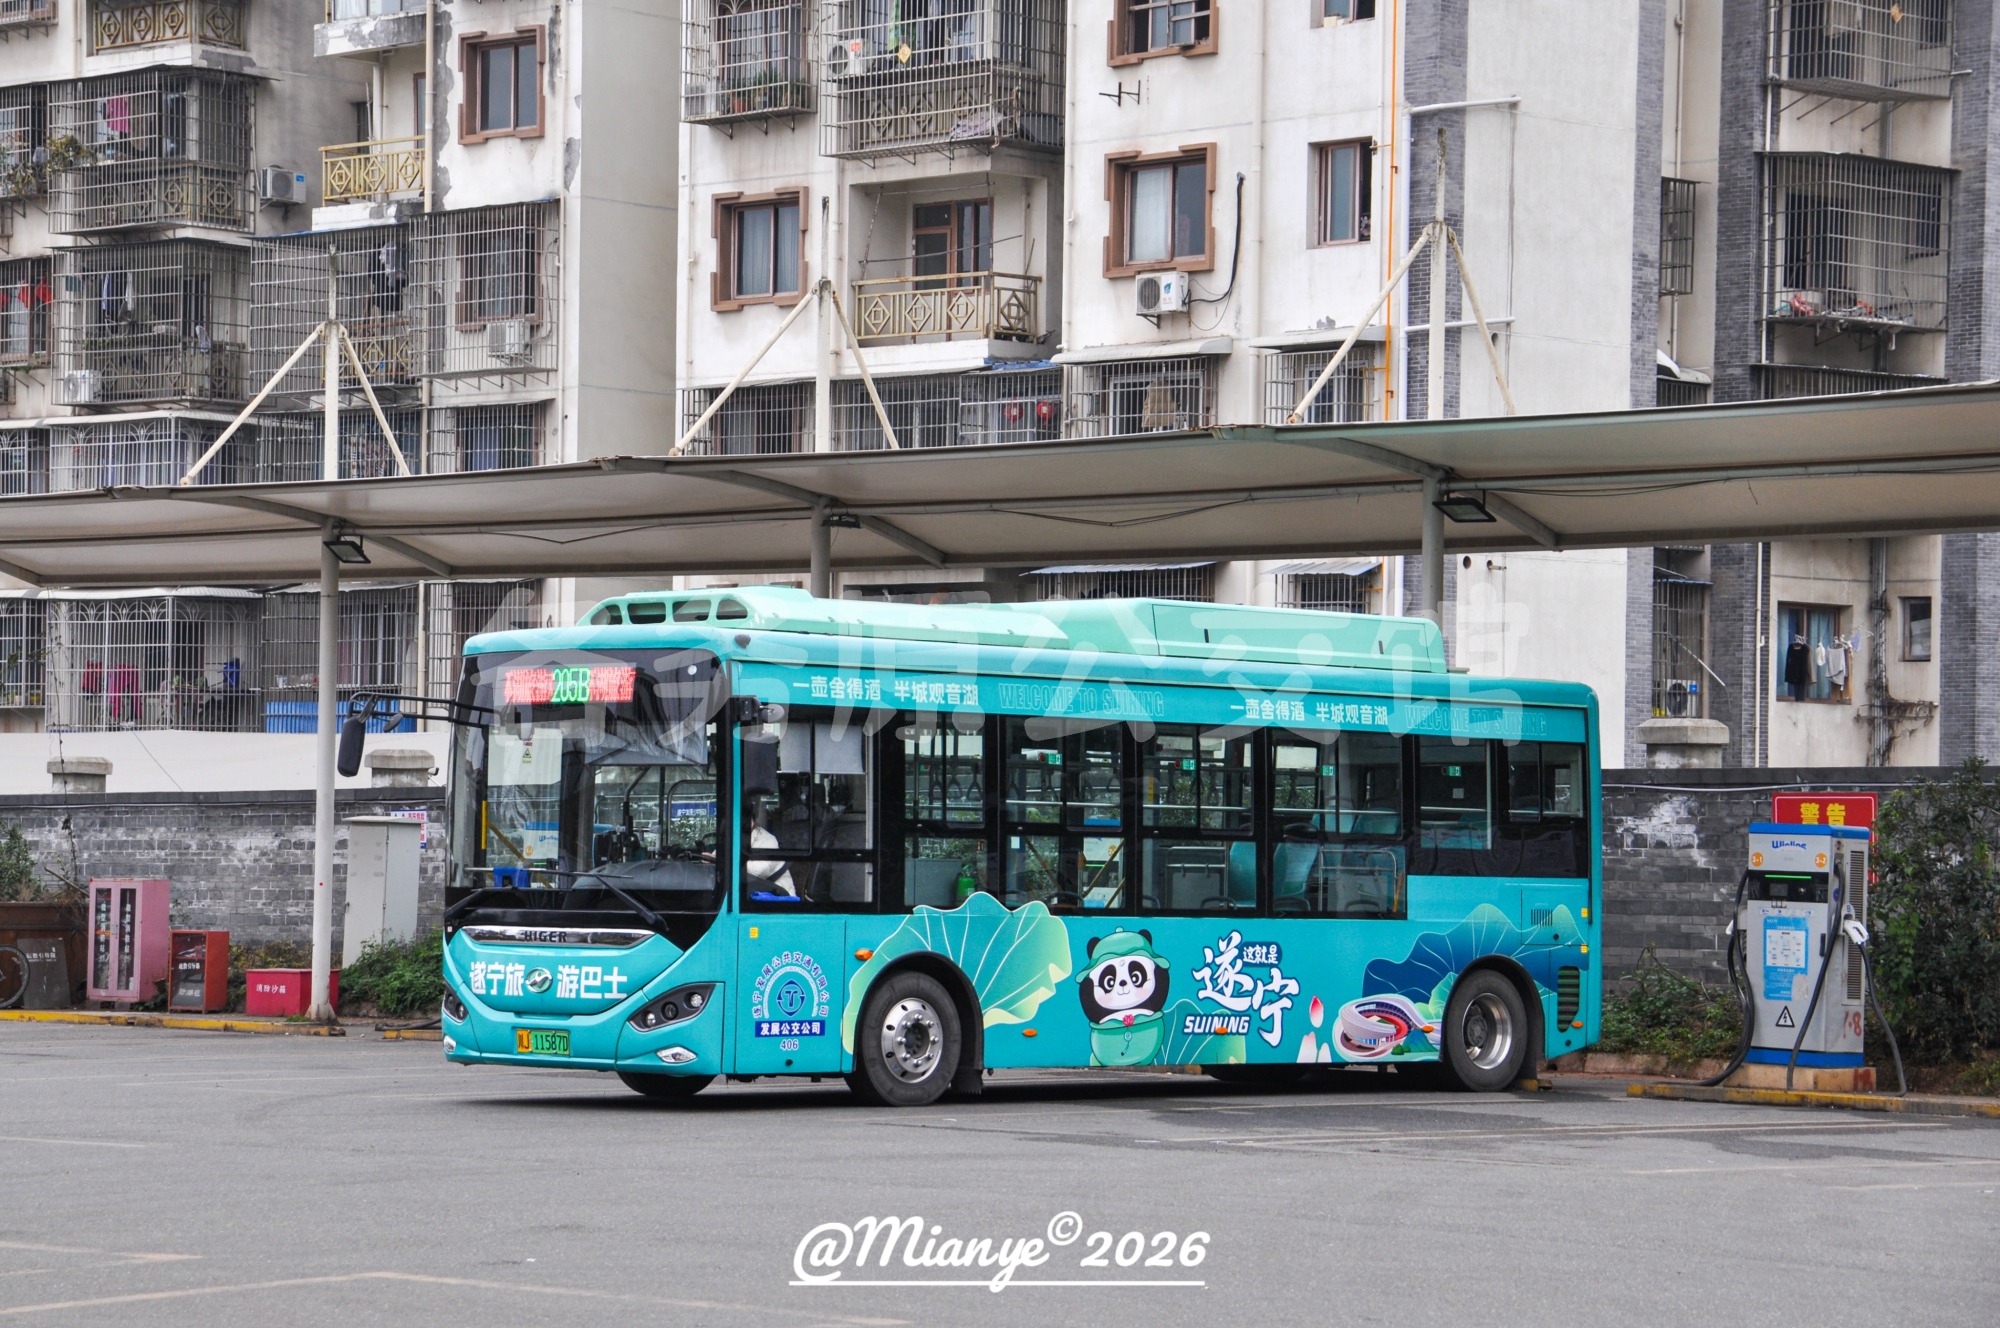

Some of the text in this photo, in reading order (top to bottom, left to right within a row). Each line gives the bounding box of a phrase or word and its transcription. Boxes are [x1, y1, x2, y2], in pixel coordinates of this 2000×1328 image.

[552, 668, 591, 703] 205B
[793, 676, 1164, 717] 一壶舍得酒 半城观音湖 WELCOME TO SUINING
[1231, 699, 1547, 736] 一壶舍得酒 半城观音湖 WELCOME TO SUINING
[1801, 803, 1846, 826] 警告
[525, 931, 566, 942] HIGER
[1242, 944, 1279, 965] 这就是
[256, 983, 286, 994] 消防沙箱
[469, 961, 628, 999] 遂宁旅 游巴士
[1192, 931, 1299, 1047] 遂宁
[760, 1022, 821, 1035] 发展公交公司
[1183, 1016, 1250, 1033] SUINING
[781, 1039, 798, 1050] 406
